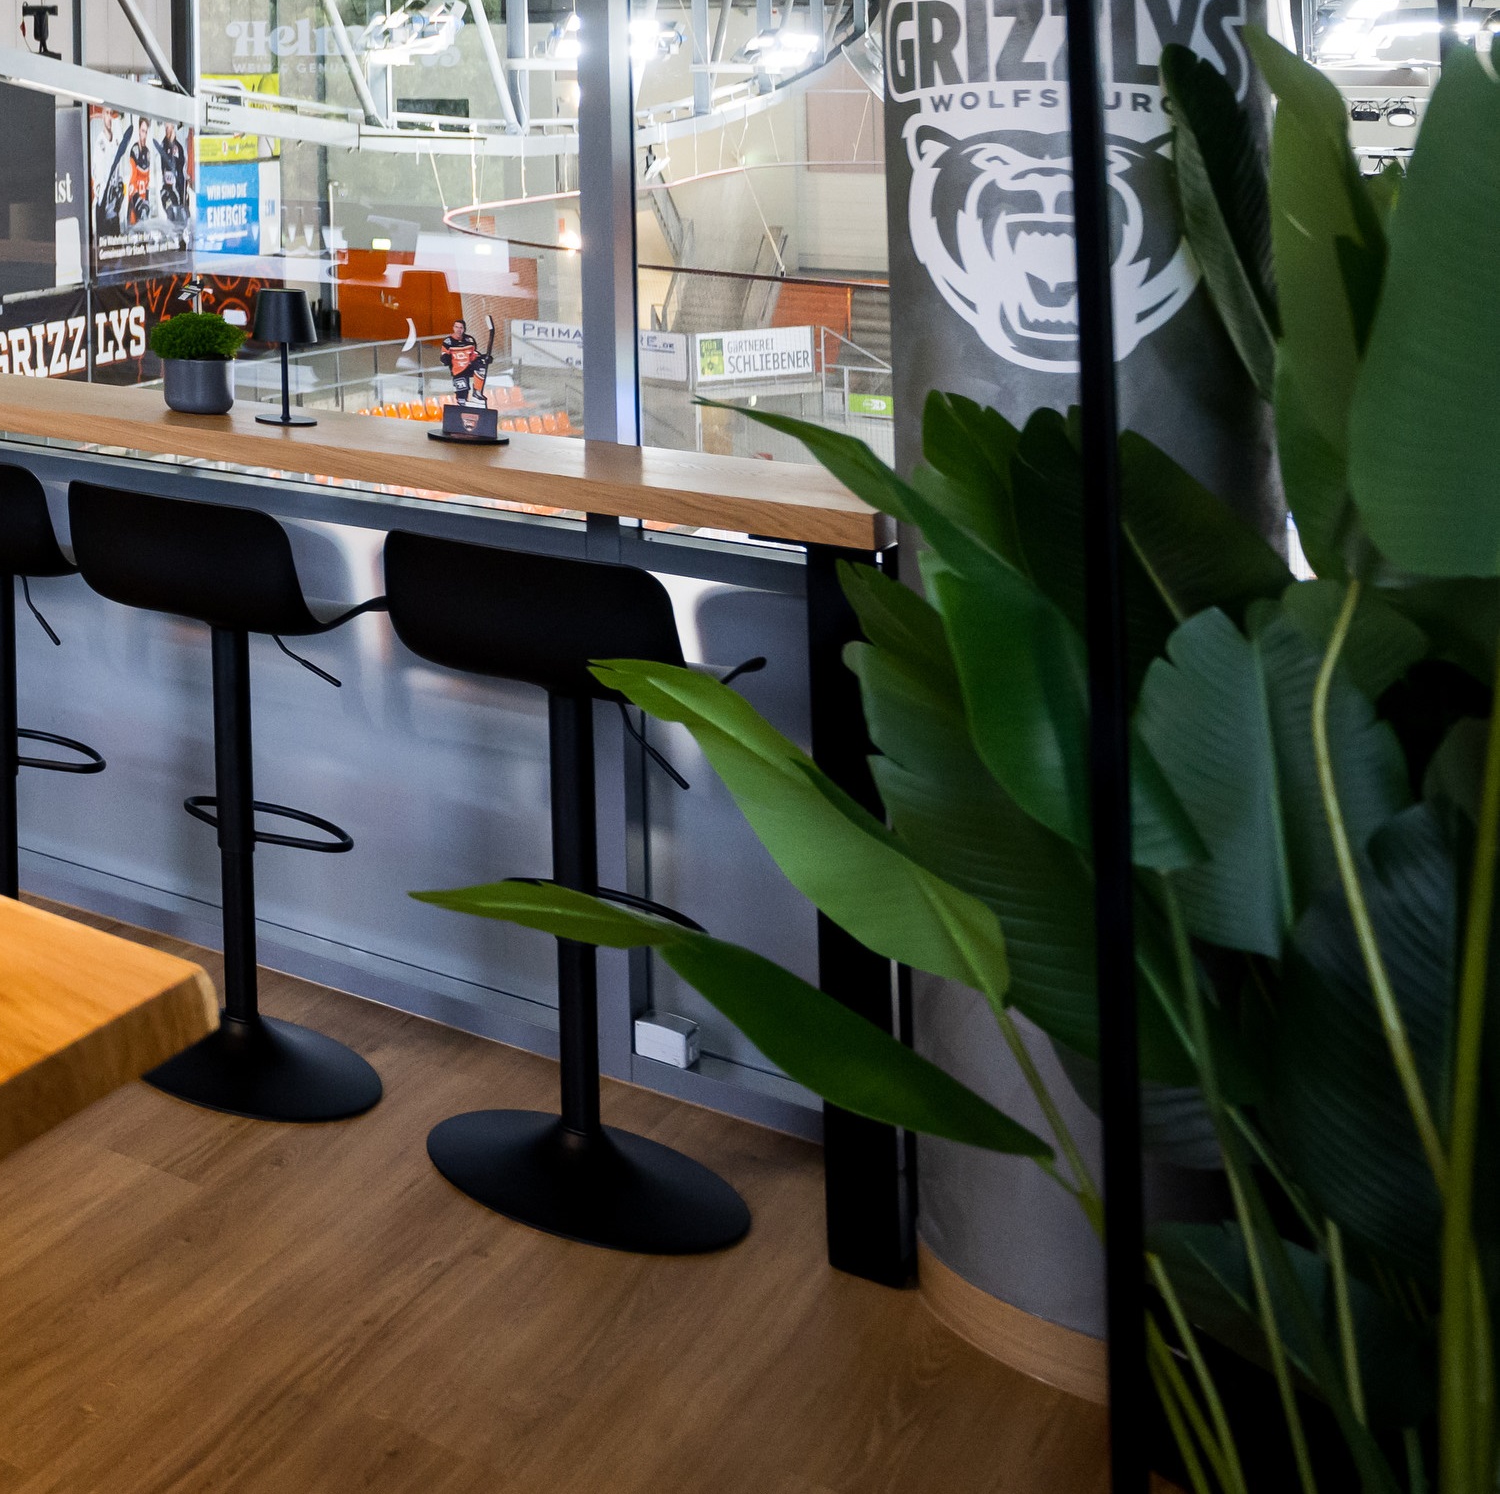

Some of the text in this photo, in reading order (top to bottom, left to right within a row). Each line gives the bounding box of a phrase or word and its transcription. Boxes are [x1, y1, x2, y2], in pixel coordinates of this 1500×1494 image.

[930, 89, 1173, 113] WOLFSUR
[206, 204, 248, 229] ENERGIE
[728, 350, 810, 374] SCHLIEBENER
